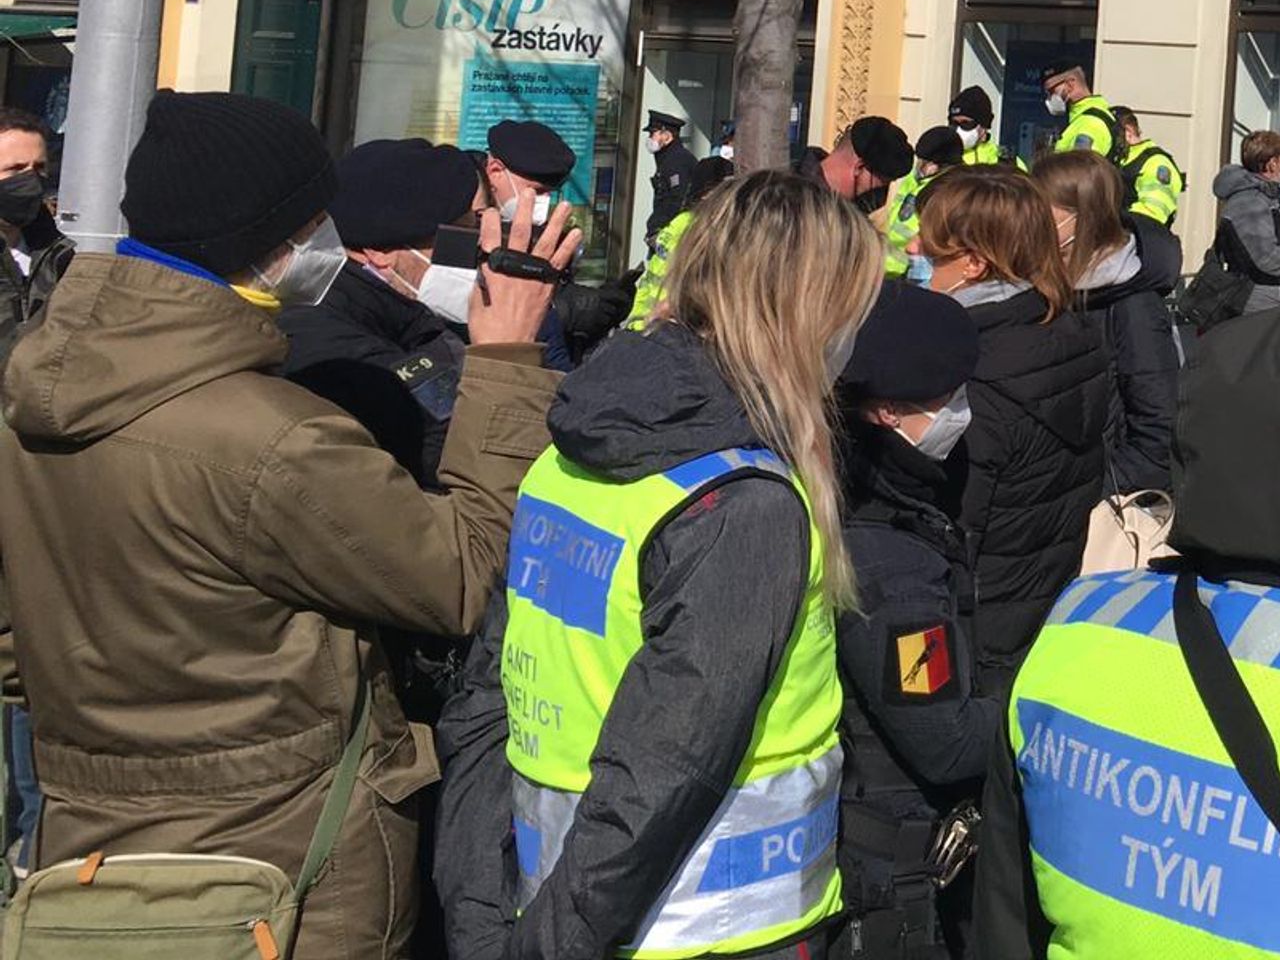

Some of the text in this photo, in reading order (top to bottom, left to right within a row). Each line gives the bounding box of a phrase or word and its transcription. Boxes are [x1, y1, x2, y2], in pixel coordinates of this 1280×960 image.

[490, 23, 603, 59] zastávky
[396, 356, 434, 382] K-9
[1120, 835, 1224, 918] TÝM
